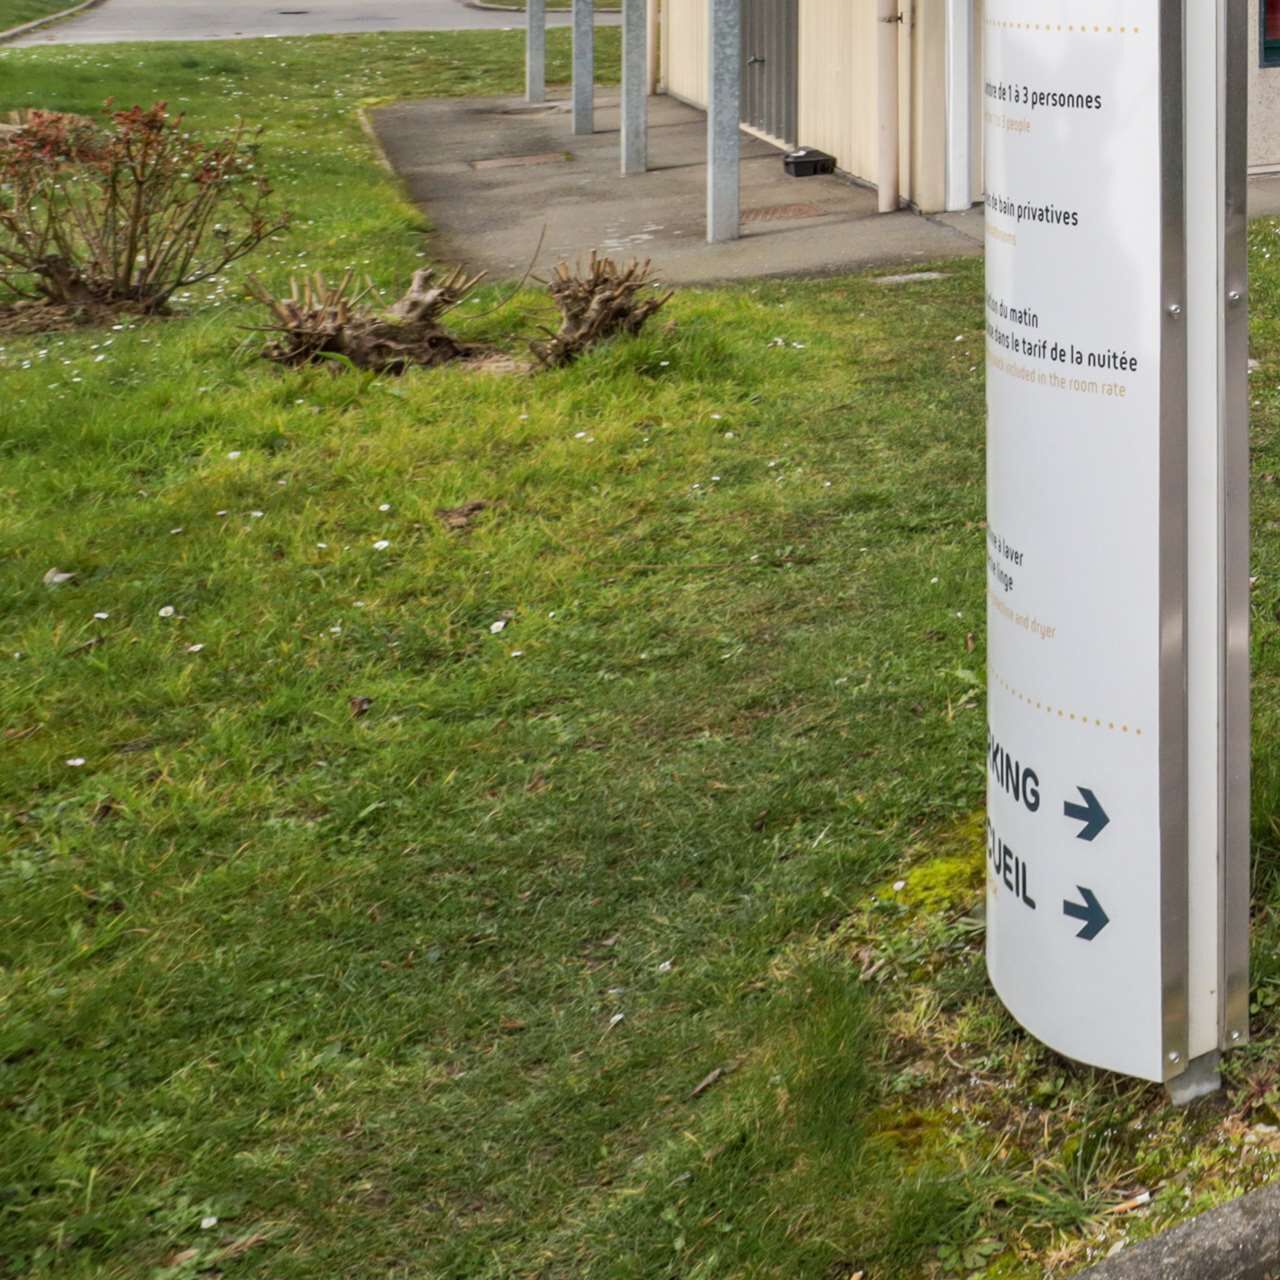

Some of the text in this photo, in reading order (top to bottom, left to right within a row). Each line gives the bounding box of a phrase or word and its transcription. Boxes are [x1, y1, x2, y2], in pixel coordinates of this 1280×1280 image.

[1023, 86, 1029, 104] 3
[1031, 90, 1102, 110] personnes
[999, 194, 1015, 217] bain
[1017, 201, 1078, 226] privatives
[1009, 306, 1039, 328] matin
[1011, 332, 1020, 353] le
[1022, 337, 1048, 359] tarif
[1050, 342, 1066, 363] de
[1071, 344, 1083, 365] la
[1088, 349, 1138, 372] nuitée
[1049, 371, 1066, 389] the
[1069, 378, 1098, 394] room
[1101, 382, 1126, 398] rate
[1003, 537, 1024, 567] laver
